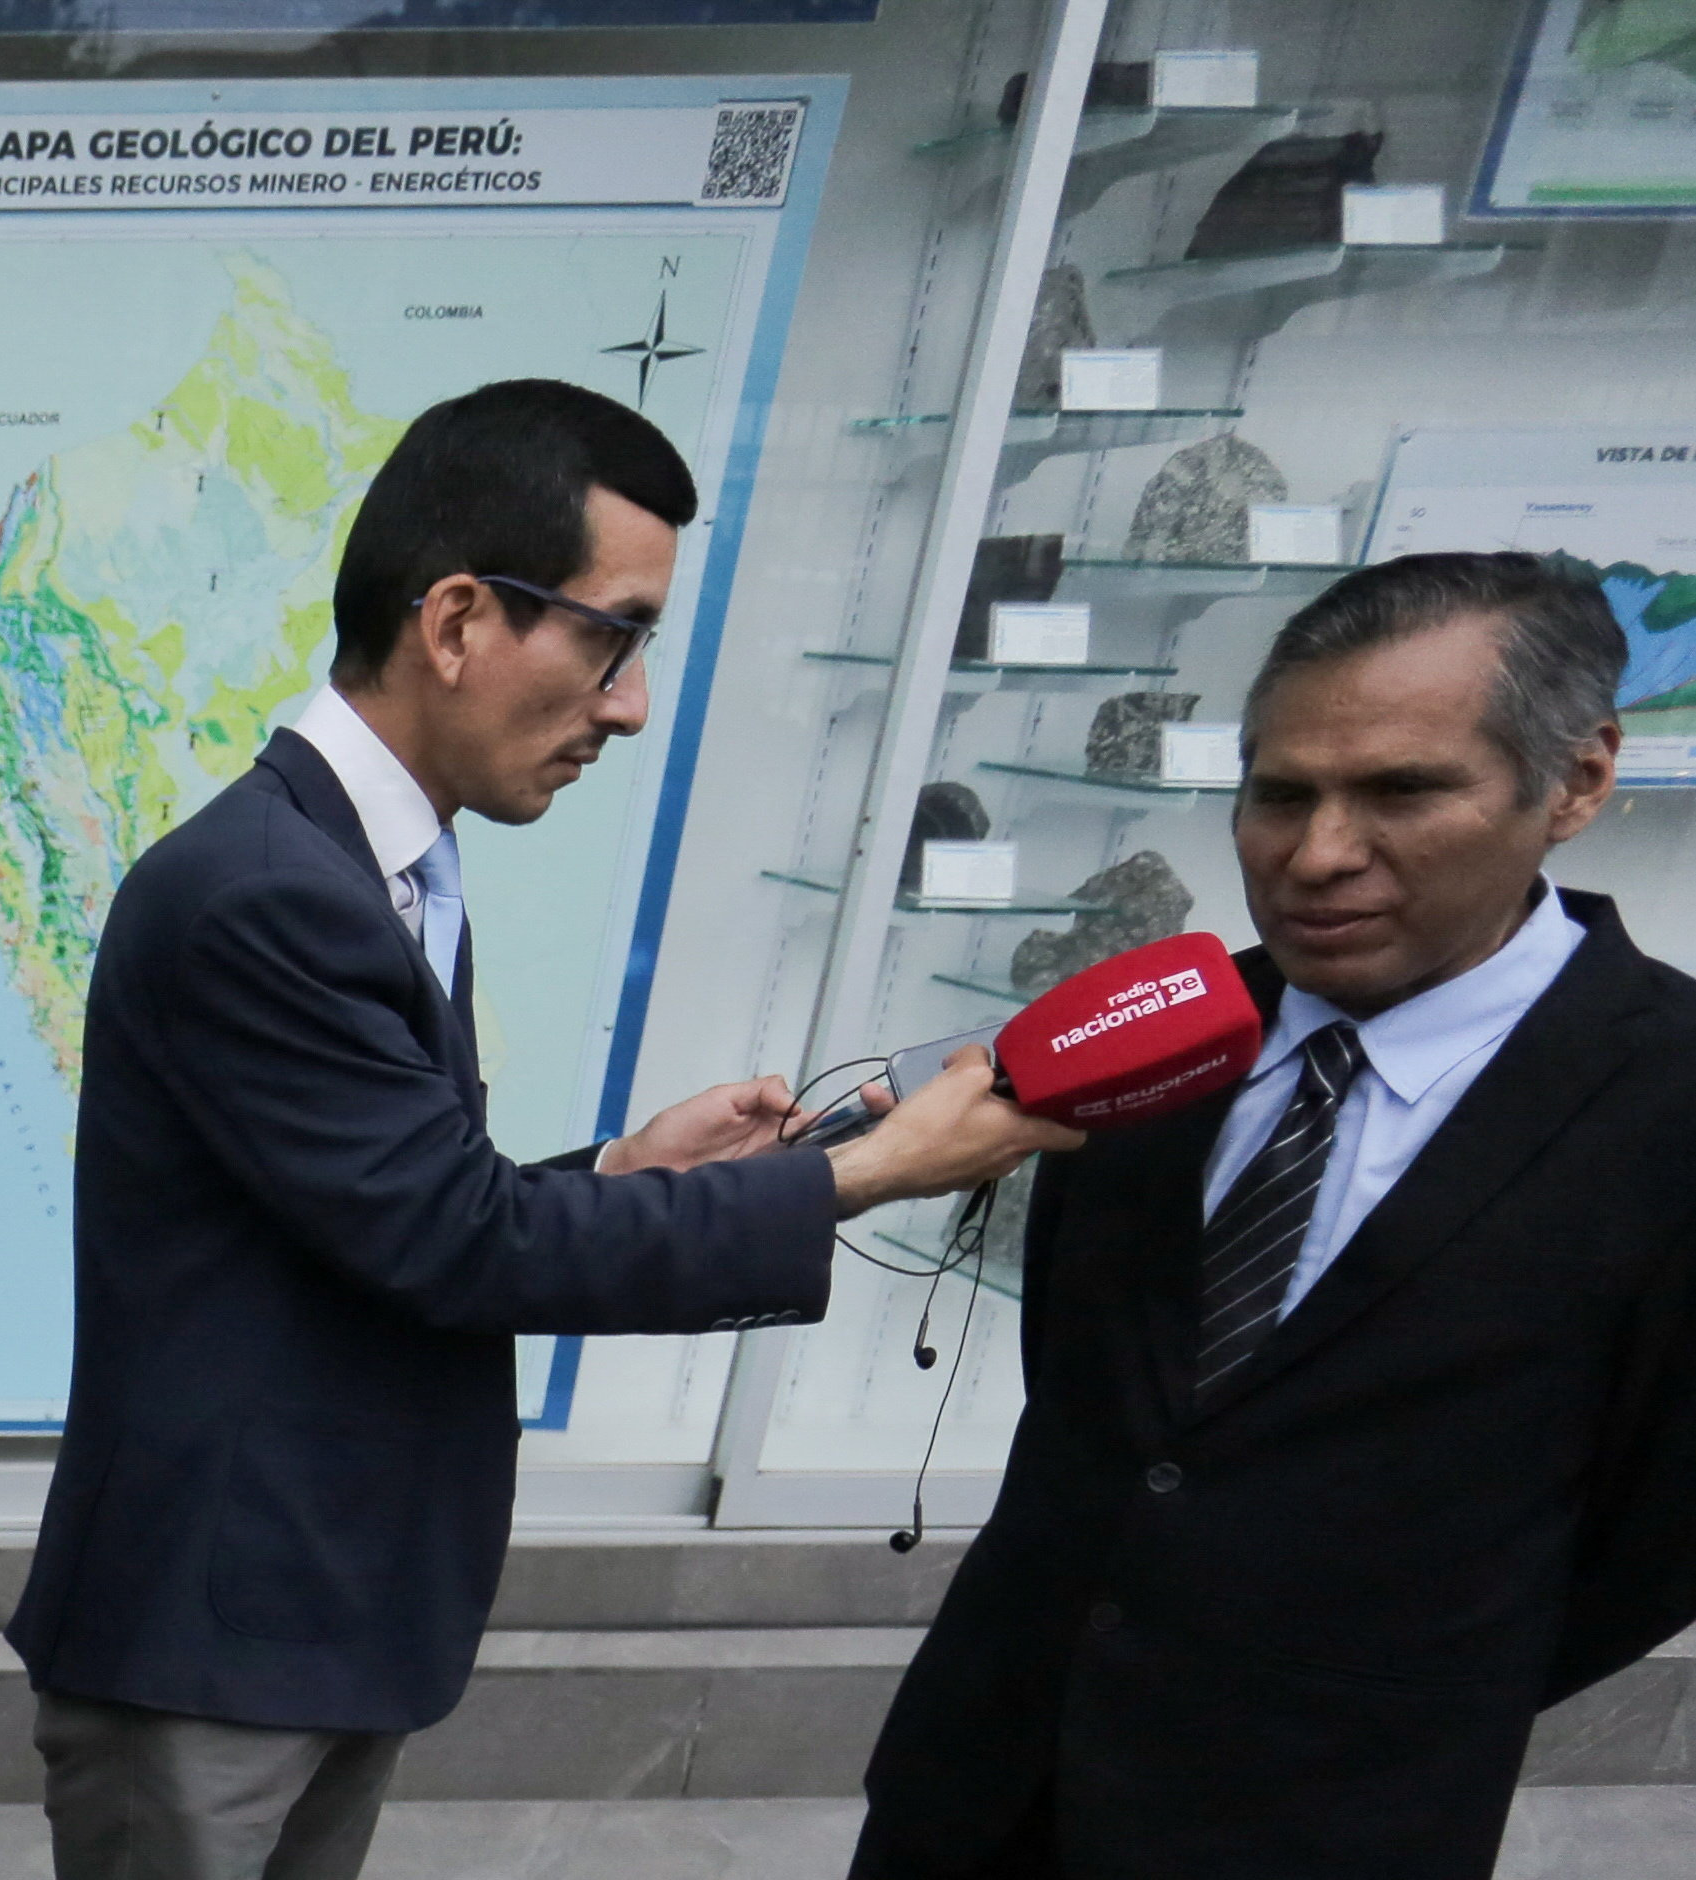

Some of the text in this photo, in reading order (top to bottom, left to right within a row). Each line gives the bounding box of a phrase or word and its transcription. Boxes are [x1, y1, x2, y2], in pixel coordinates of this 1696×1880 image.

[88, 120, 313, 159] GEOLÓGICO
[323, 126, 397, 157] DEL
[408, 117, 523, 157] PERÚ:
[111, 173, 242, 195] RECURSOS
[249, 172, 347, 194] MINERO
[369, 165, 543, 193] ENERGÉTICOS
[660, 255, 681, 280] N
[404, 304, 484, 321] COLOMBIA
[1596, 446, 1655, 463] VISTA
[1660, 445, 1689, 462] DE
[1108, 981, 1158, 1008] radio
[1051, 990, 1167, 1053] nacional
